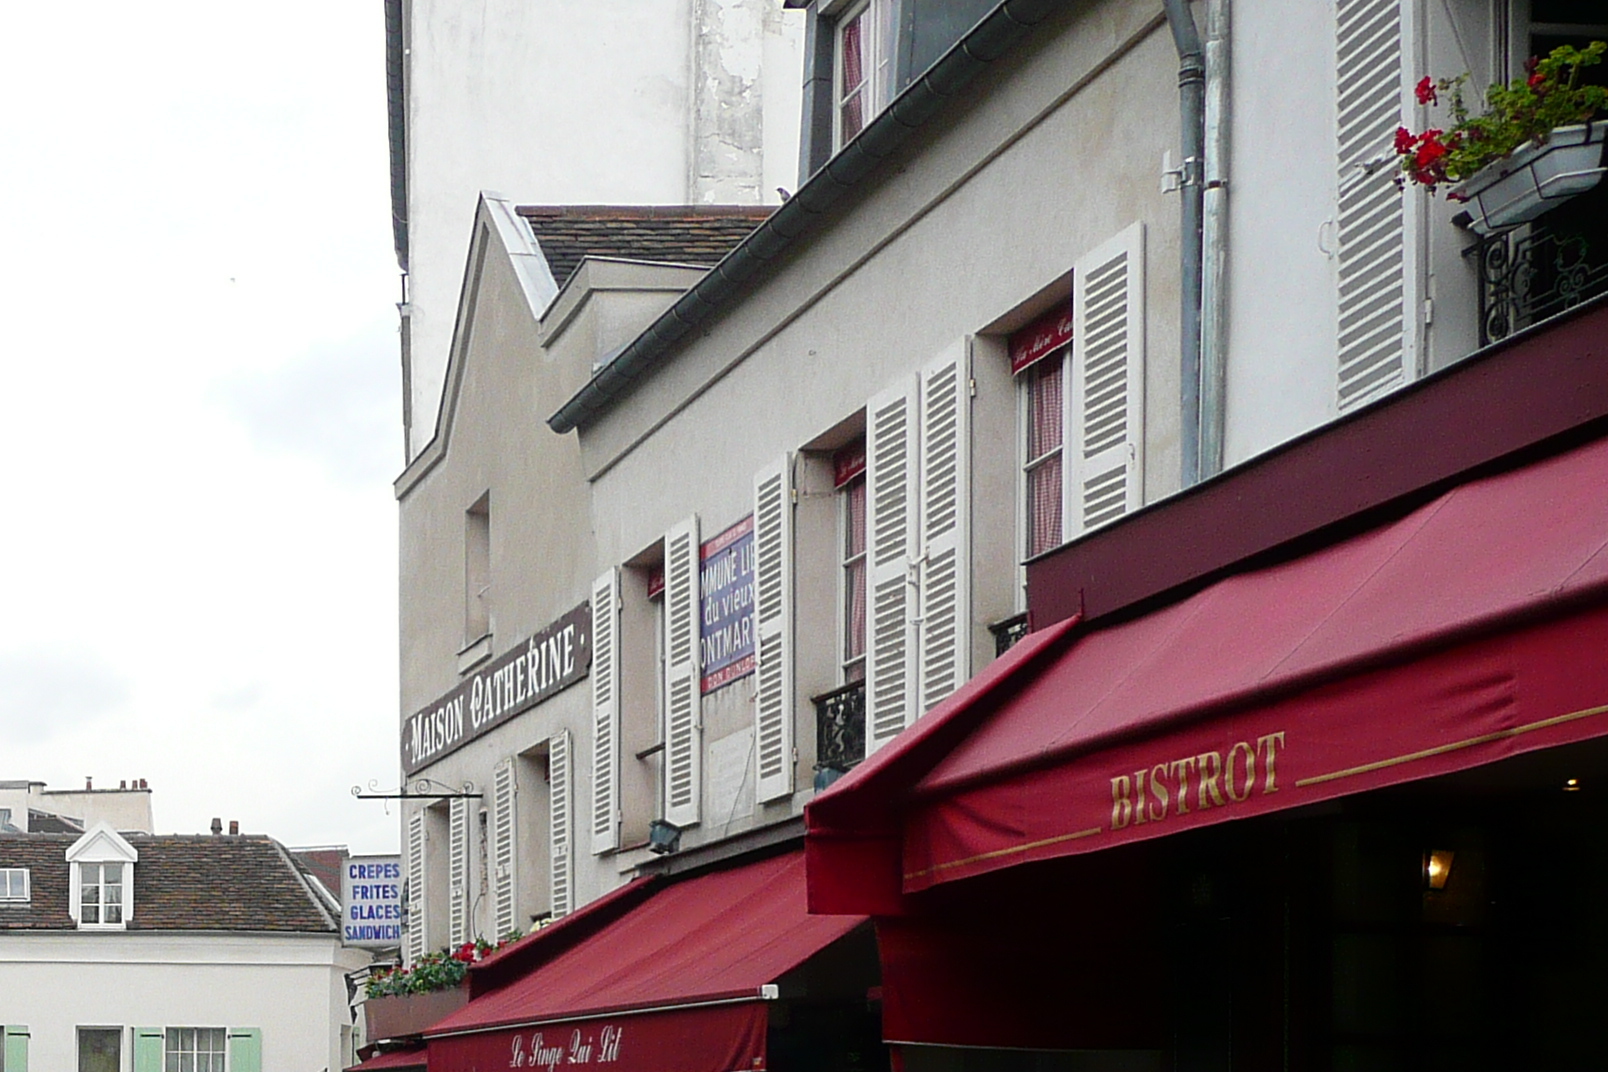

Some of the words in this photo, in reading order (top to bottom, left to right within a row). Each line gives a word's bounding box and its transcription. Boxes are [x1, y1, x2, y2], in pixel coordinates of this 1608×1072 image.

[705, 596, 719, 626] du
[722, 582, 755, 616] vieux
[411, 695, 464, 764] MAISON
[470, 624, 575, 729] CATHERINE
[1110, 731, 1285, 830] BISTROT
[349, 864, 401, 879] CREPES
[352, 885, 399, 900] FRITES
[350, 905, 401, 921] GLACES
[344, 925, 401, 940] SANDWICH
[509, 1034, 525, 1068] Le
[567, 1028, 593, 1064] Qui
[597, 1024, 623, 1062] Lit
